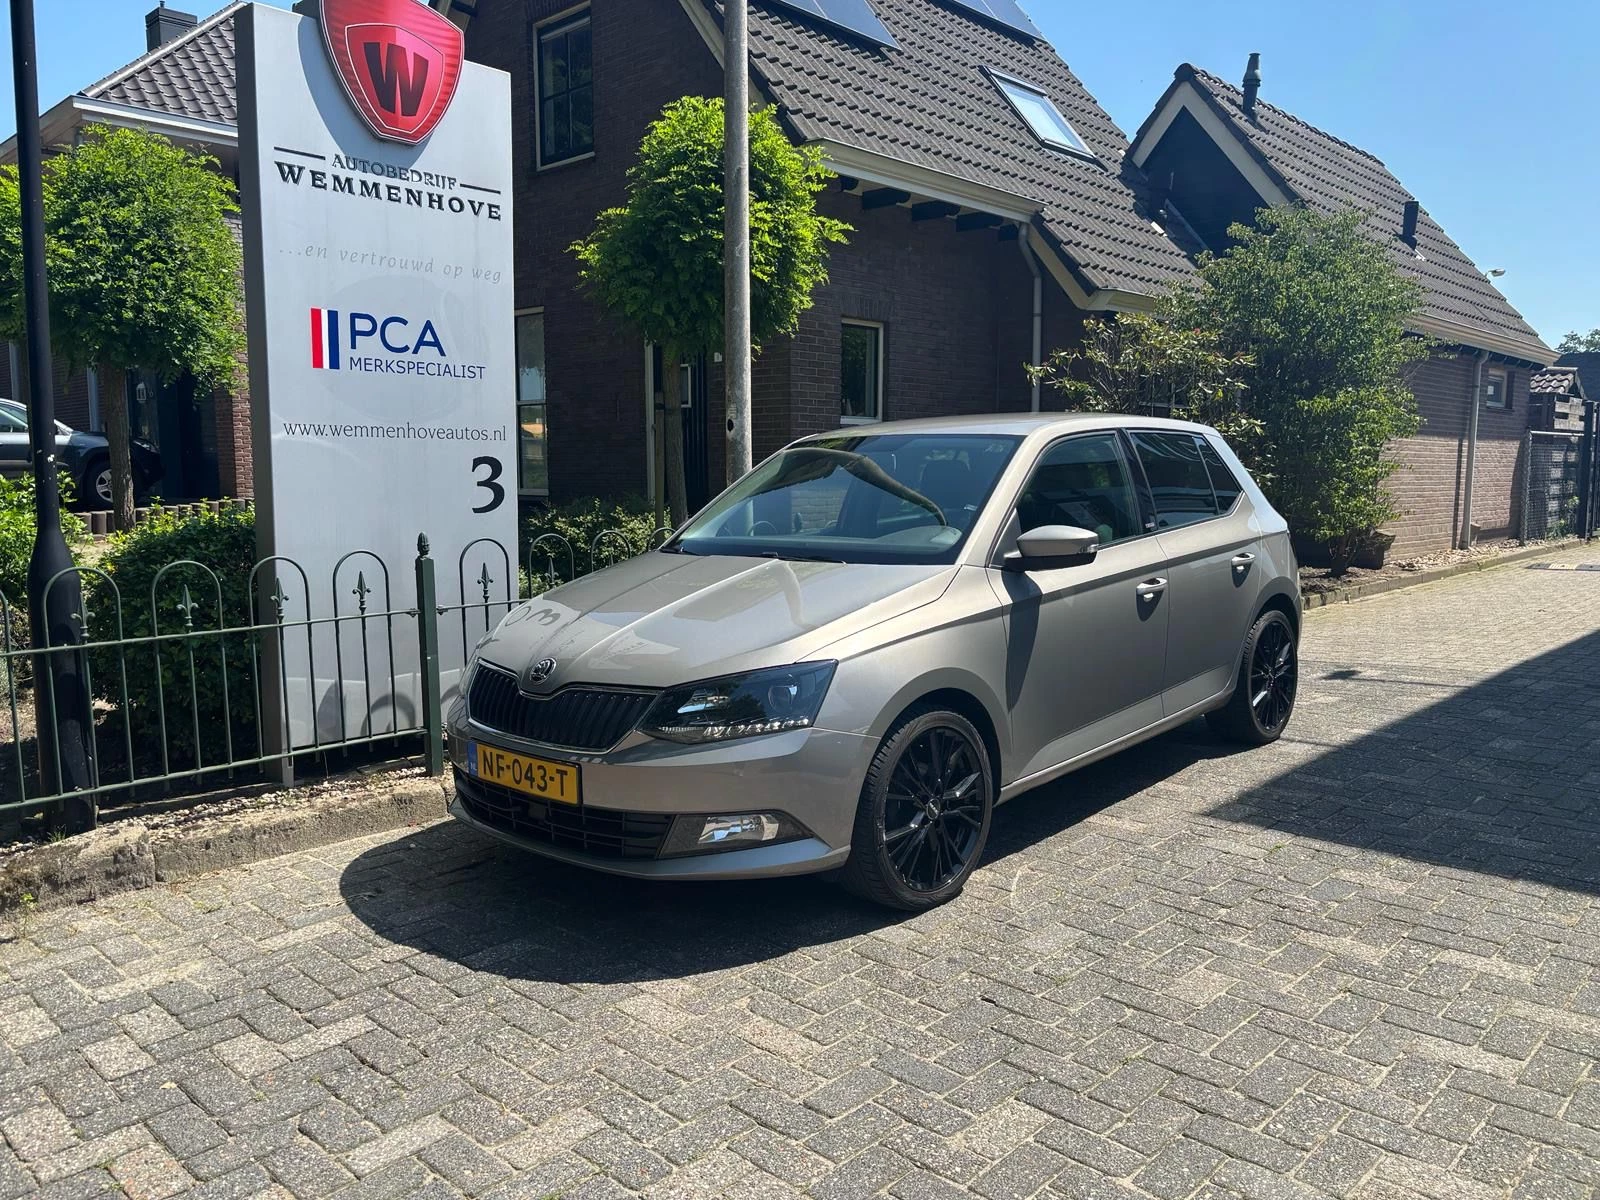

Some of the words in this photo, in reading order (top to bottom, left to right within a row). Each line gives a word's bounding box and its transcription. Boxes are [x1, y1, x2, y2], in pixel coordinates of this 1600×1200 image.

[362, 41, 429, 117] W
[274, 160, 502, 221] WEMMENHOVE
[331, 153, 458, 190] AUTOBEDRIJF
[339, 249, 434, 273] vertrouwd
[443, 263, 464, 278] op
[471, 266, 502, 284] weg
[349, 312, 447, 357] PCA
[349, 356, 486, 380] MERKSPECIALIST
[283, 422, 507, 441] www.wemmenhoveautos.nl
[471, 455, 506, 514] 3
[482, 750, 569, 797] NF-043-T
